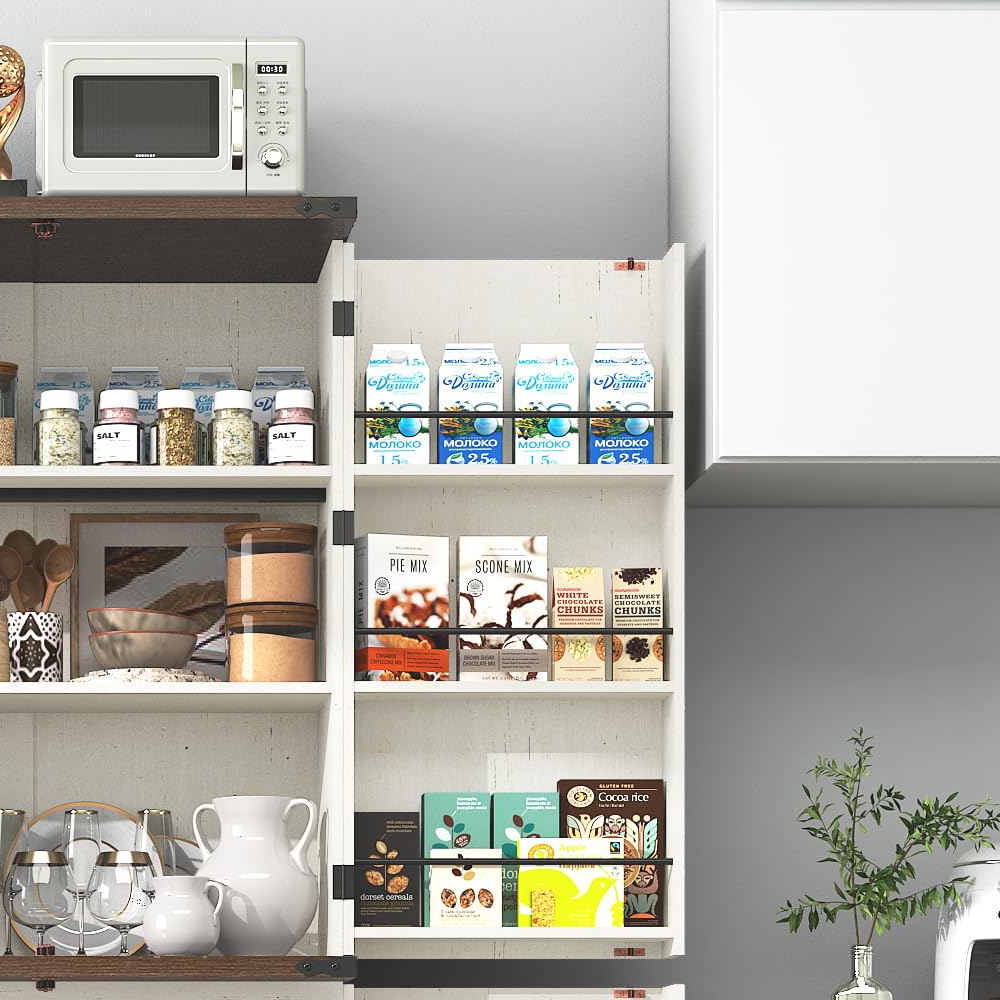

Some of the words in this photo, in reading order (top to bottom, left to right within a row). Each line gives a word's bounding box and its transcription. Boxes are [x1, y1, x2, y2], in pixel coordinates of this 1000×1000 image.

[261, 65, 283, 73] 00:30
[97, 432, 120, 440] SALT
[272, 432, 296, 440] SALT
[369, 441, 422, 449] МОЛОКО
[443, 439, 498, 448] МОЛОКО
[518, 441, 571, 449] МОЛОКО
[594, 439, 649, 448] МОЛОКО
[390, 558, 405, 573] PIE
[410, 560, 428, 573] MIX
[475, 560, 509, 574] SCONE
[514, 560, 533, 574] MIX
[557, 606, 604, 614] CHUNKS
[615, 606, 661, 615] CHUNKS
[598, 792, 629, 802] Cocoa
[632, 792, 650, 802] rice
[559, 843, 586, 853] Apple
